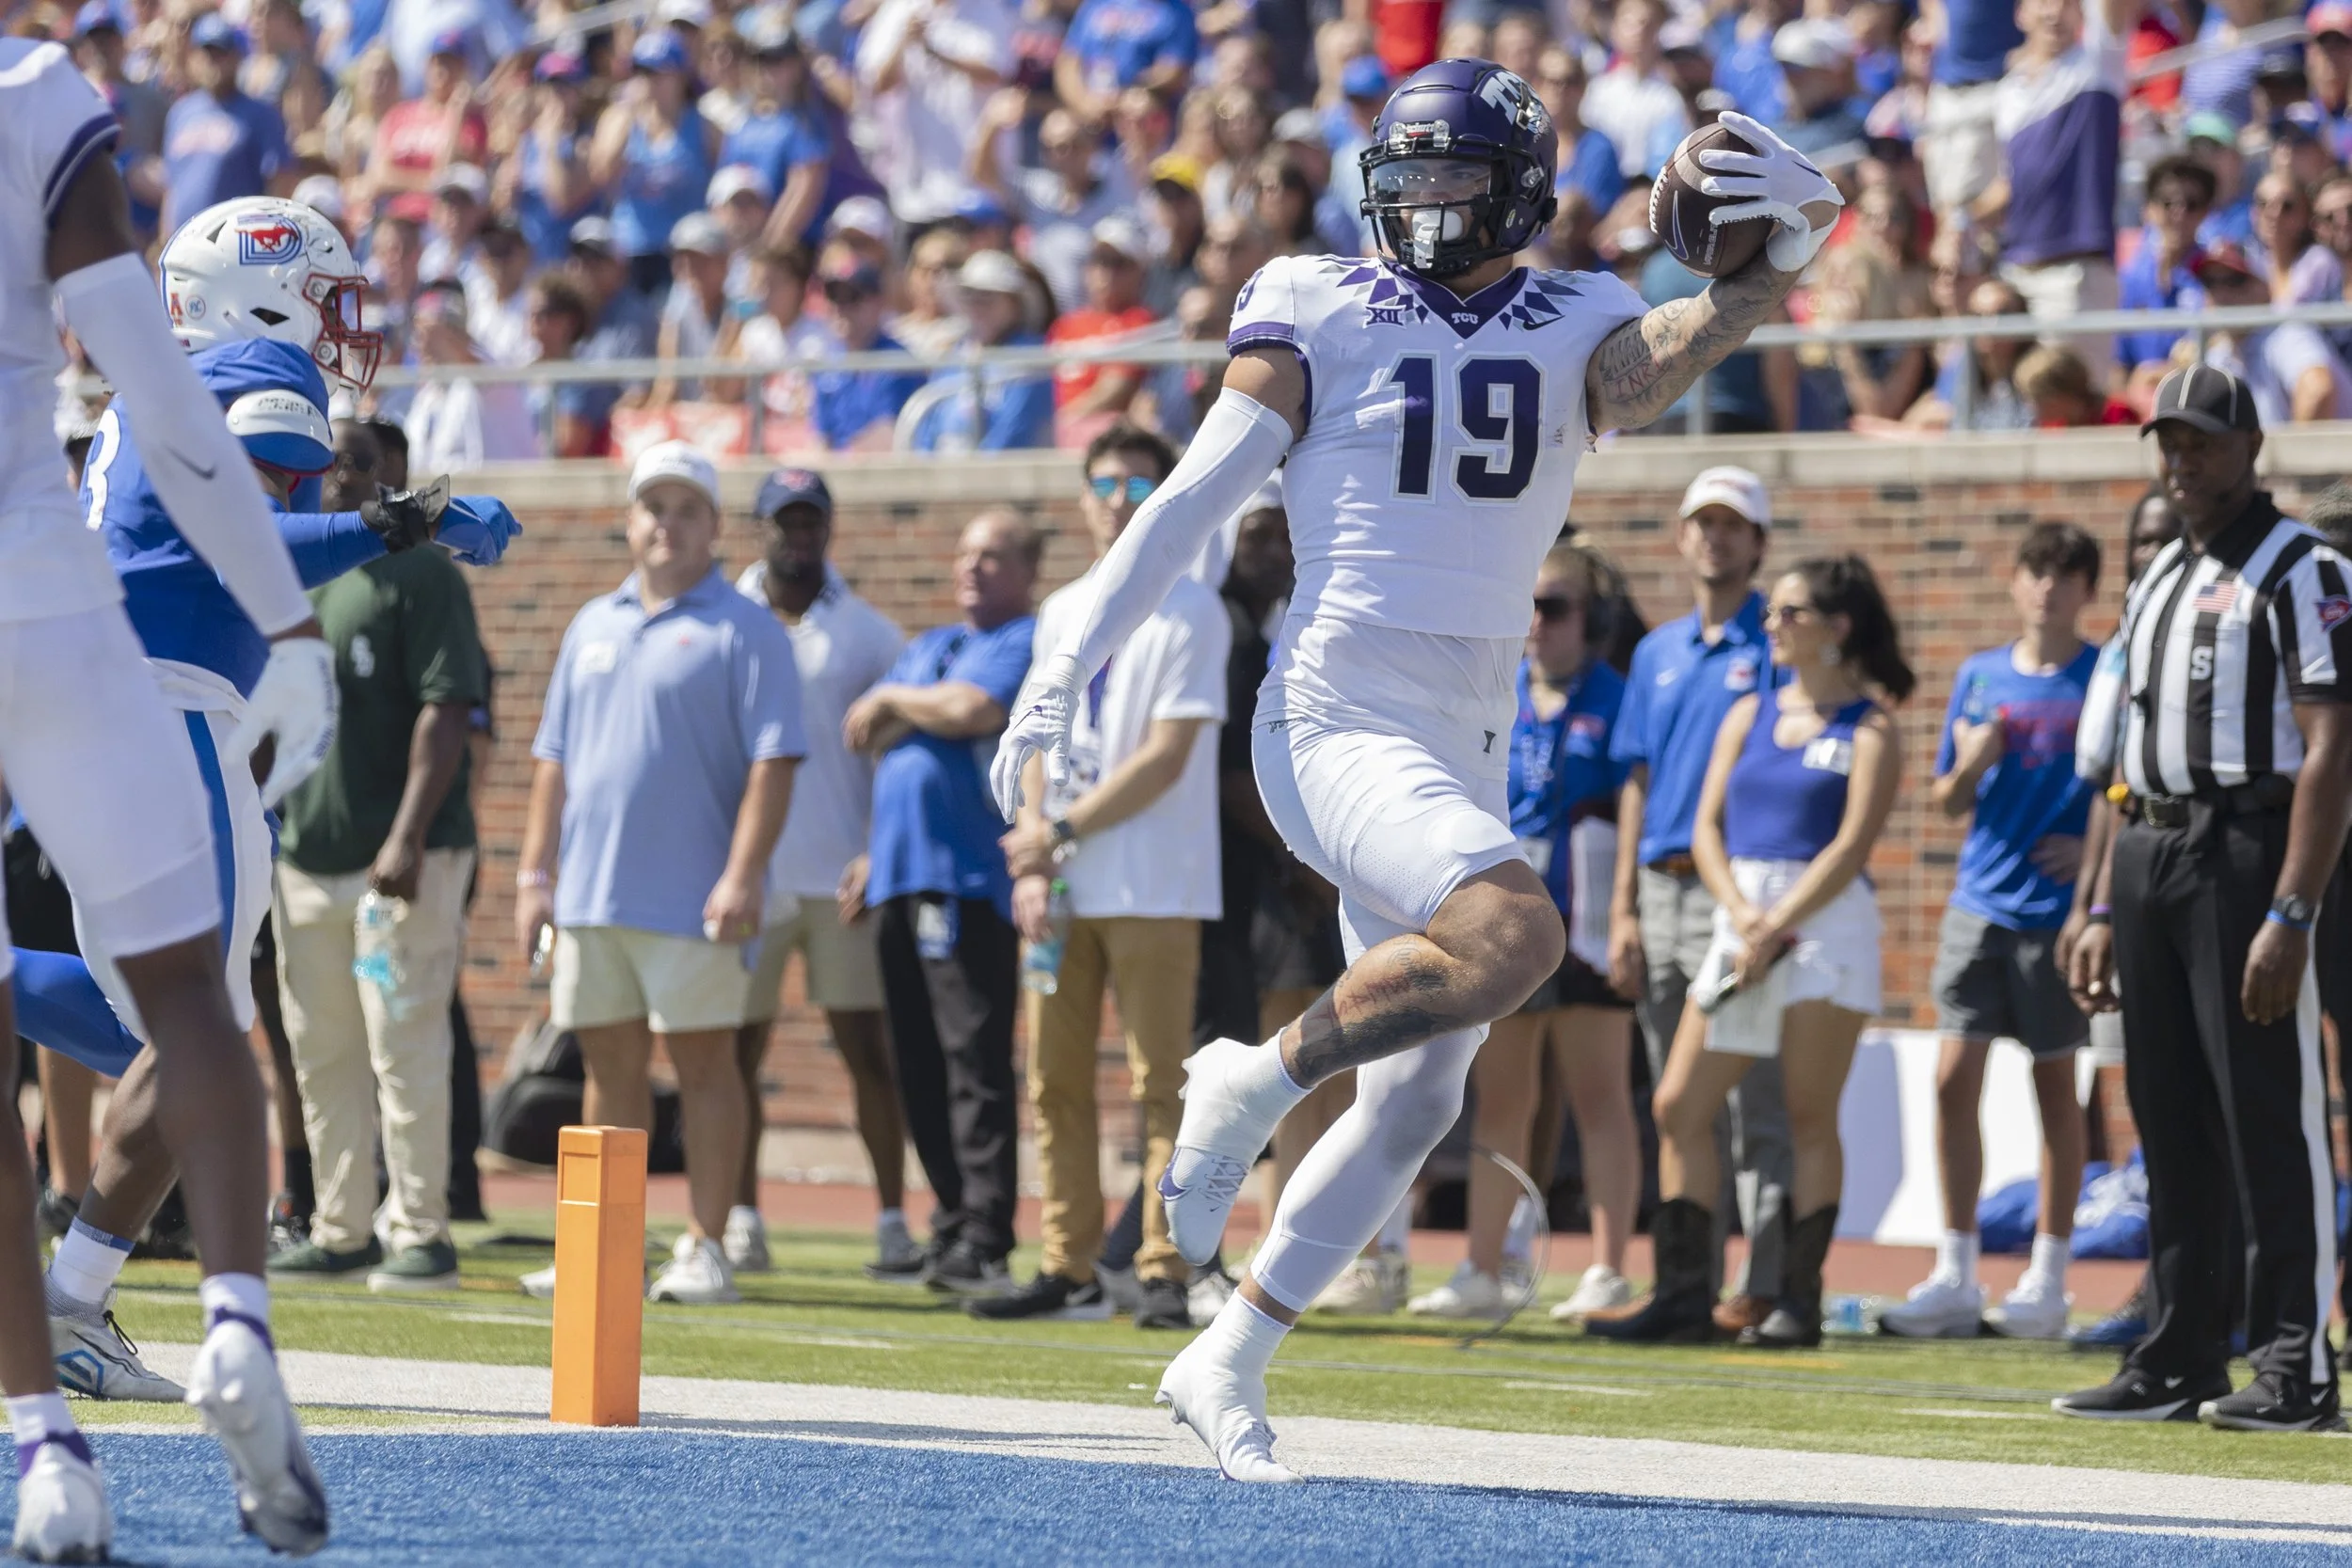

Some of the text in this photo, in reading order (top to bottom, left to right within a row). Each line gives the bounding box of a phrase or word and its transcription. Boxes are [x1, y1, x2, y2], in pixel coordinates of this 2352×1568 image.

[1365, 306, 1406, 327] XII
[1451, 312, 1479, 325] TCU
[1378, 349, 1548, 507] 19
[2189, 645, 2214, 681] S
